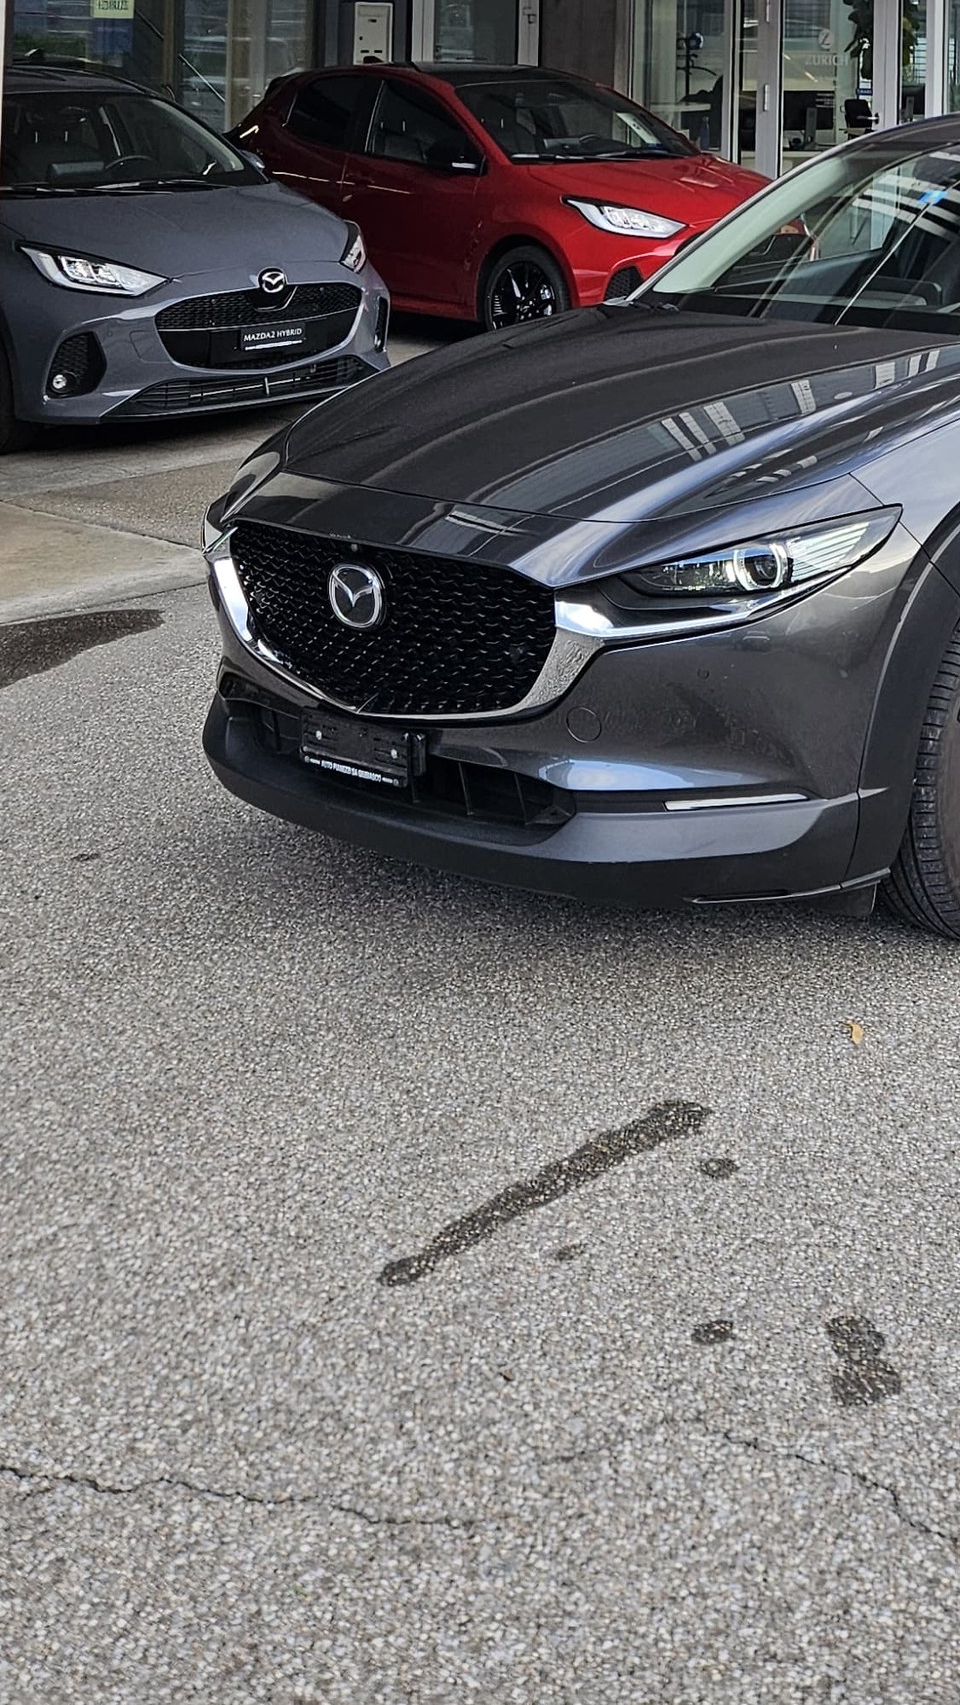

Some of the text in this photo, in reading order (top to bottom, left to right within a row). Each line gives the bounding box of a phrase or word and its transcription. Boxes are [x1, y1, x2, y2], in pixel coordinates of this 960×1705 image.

[805, 55, 849, 66] ZURICH
[243, 328, 302, 342] MAZDA2 HYBRID
